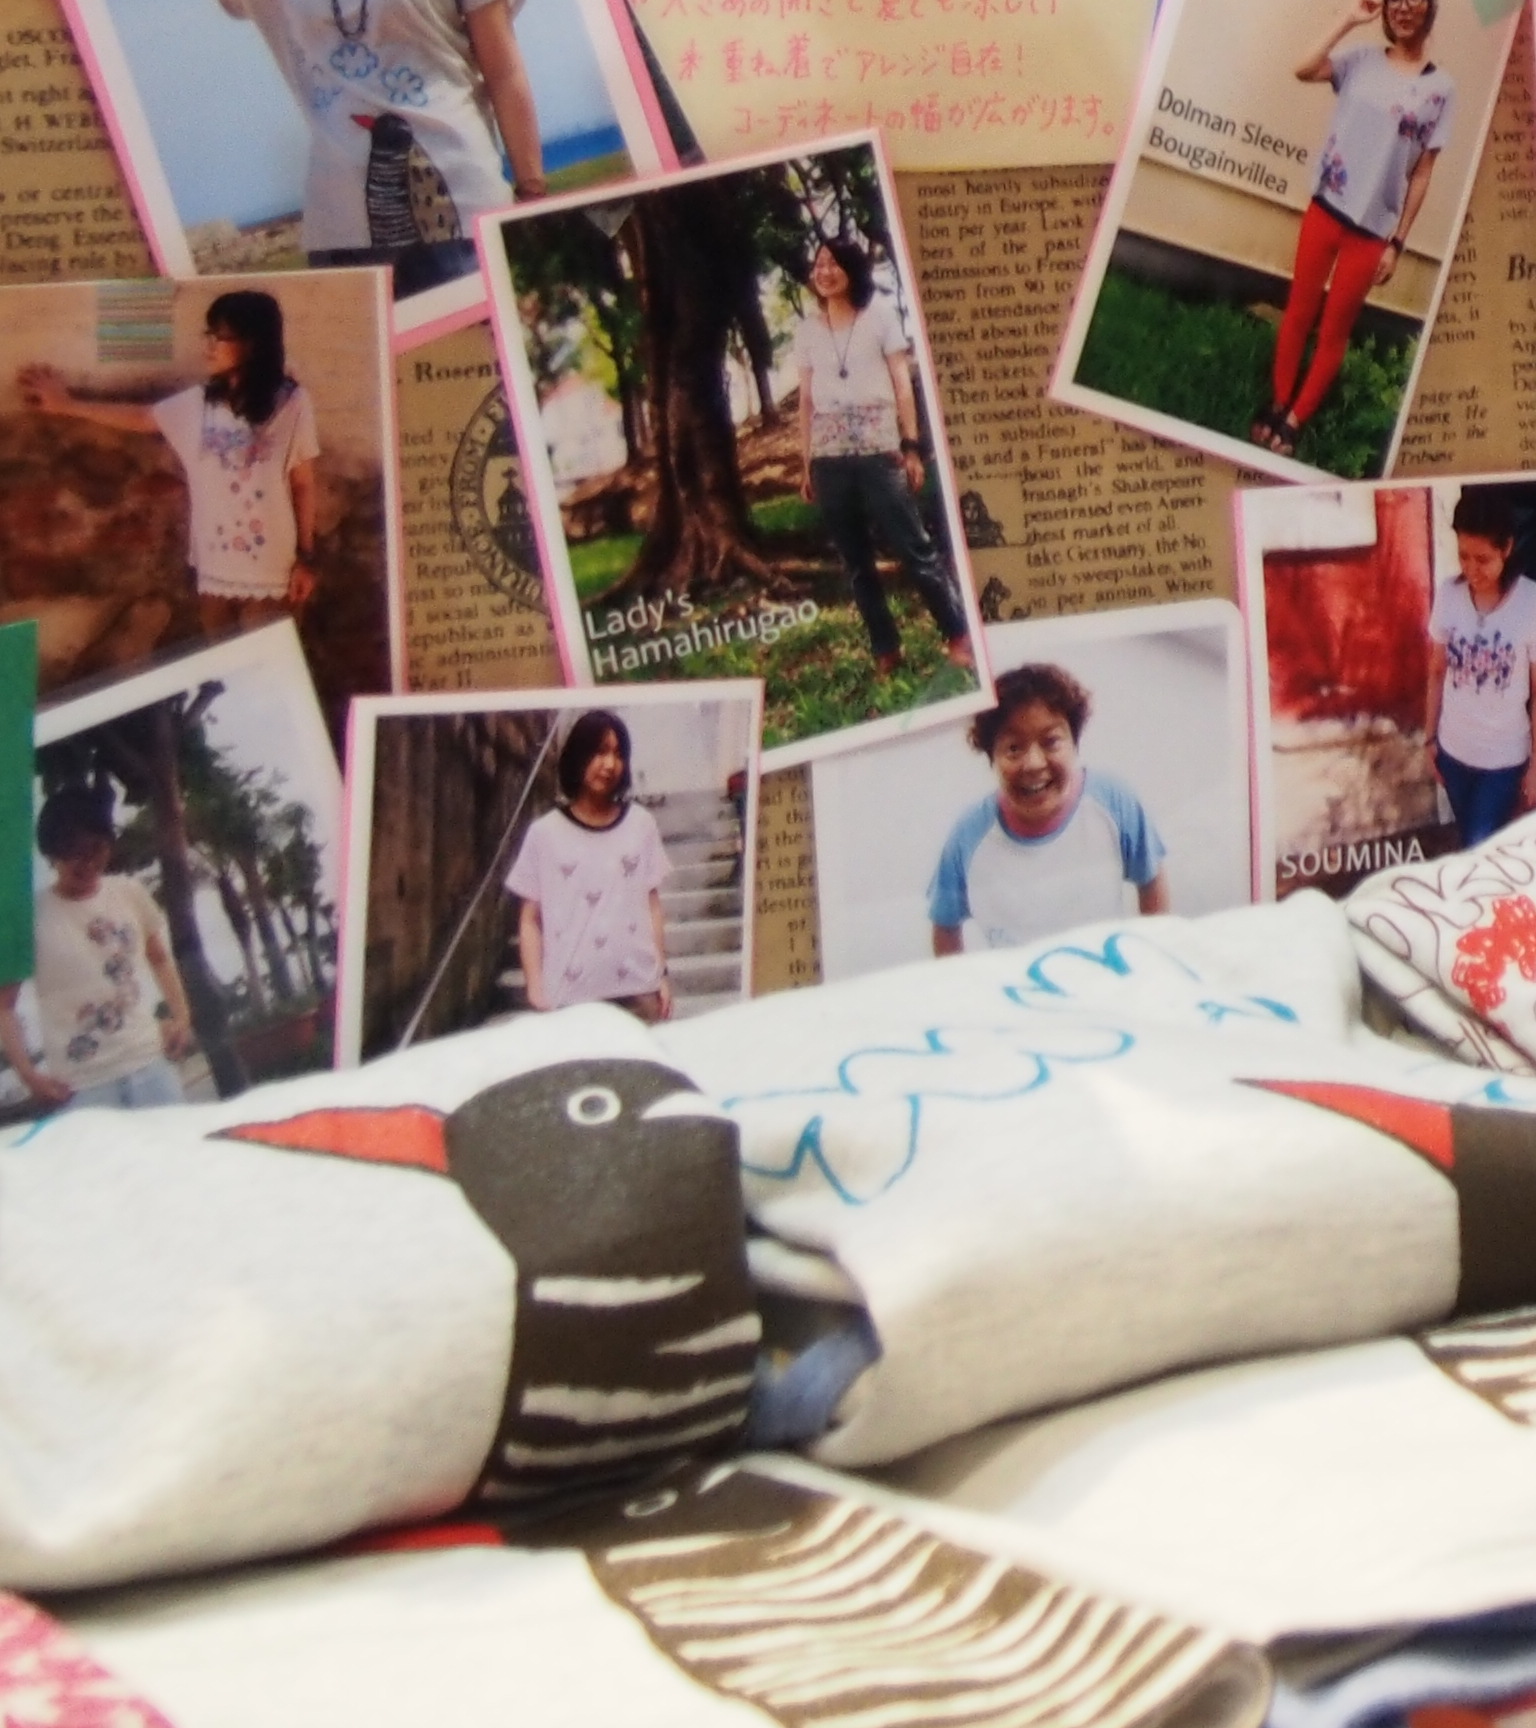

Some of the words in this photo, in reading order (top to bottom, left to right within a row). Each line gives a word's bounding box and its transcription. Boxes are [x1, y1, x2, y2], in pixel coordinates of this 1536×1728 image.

[1148, 125, 1289, 195] Bougainvillea
[1157, 85, 1238, 138] Dolman
[1241, 123, 1309, 165] Sleeve
[585, 587, 695, 641] Lady's
[591, 598, 820, 677] Hamahirugao
[1280, 836, 1427, 879] SOUMINA
